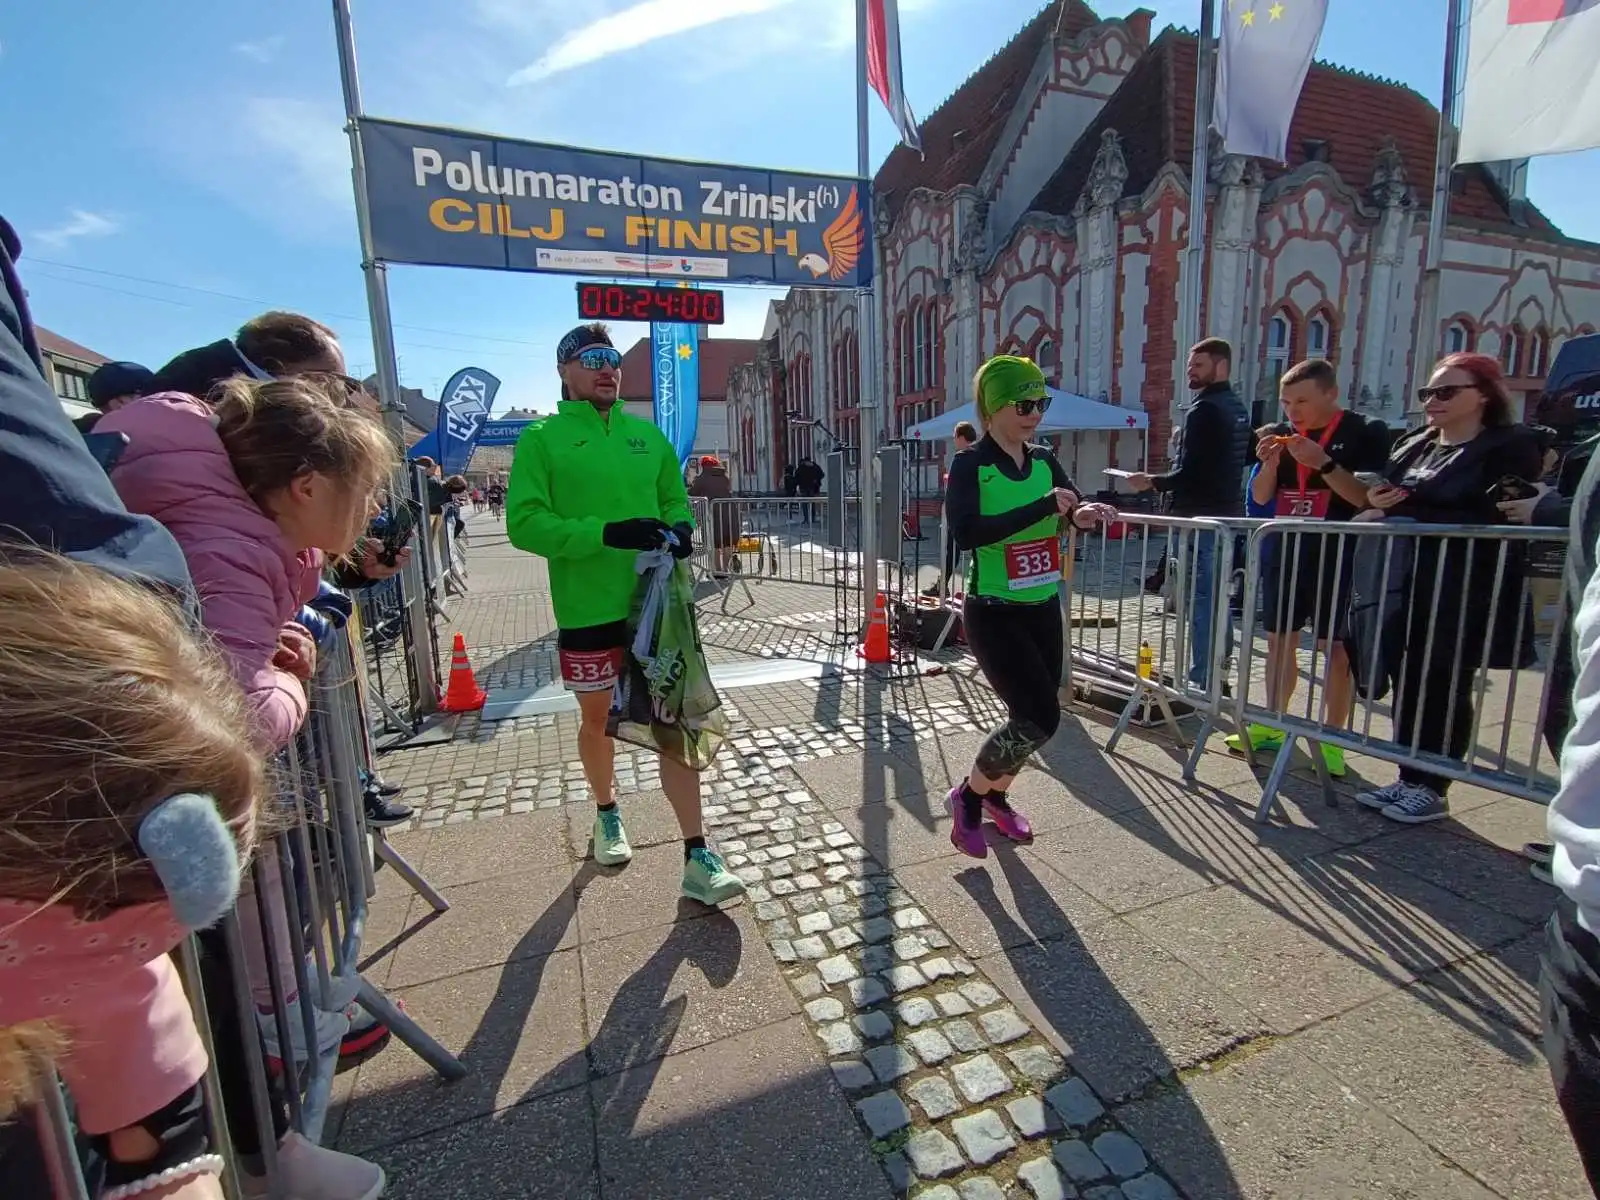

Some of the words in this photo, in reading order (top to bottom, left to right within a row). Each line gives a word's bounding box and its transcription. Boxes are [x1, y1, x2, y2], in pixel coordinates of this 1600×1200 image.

[412, 146, 683, 211] Polumaraton
[429, 198, 565, 241] CILJ
[625, 215, 798, 256] FINISH
[582, 286, 721, 321] 00:24:00
[1015, 551, 1051, 576] 333
[570, 660, 615, 681] 334
